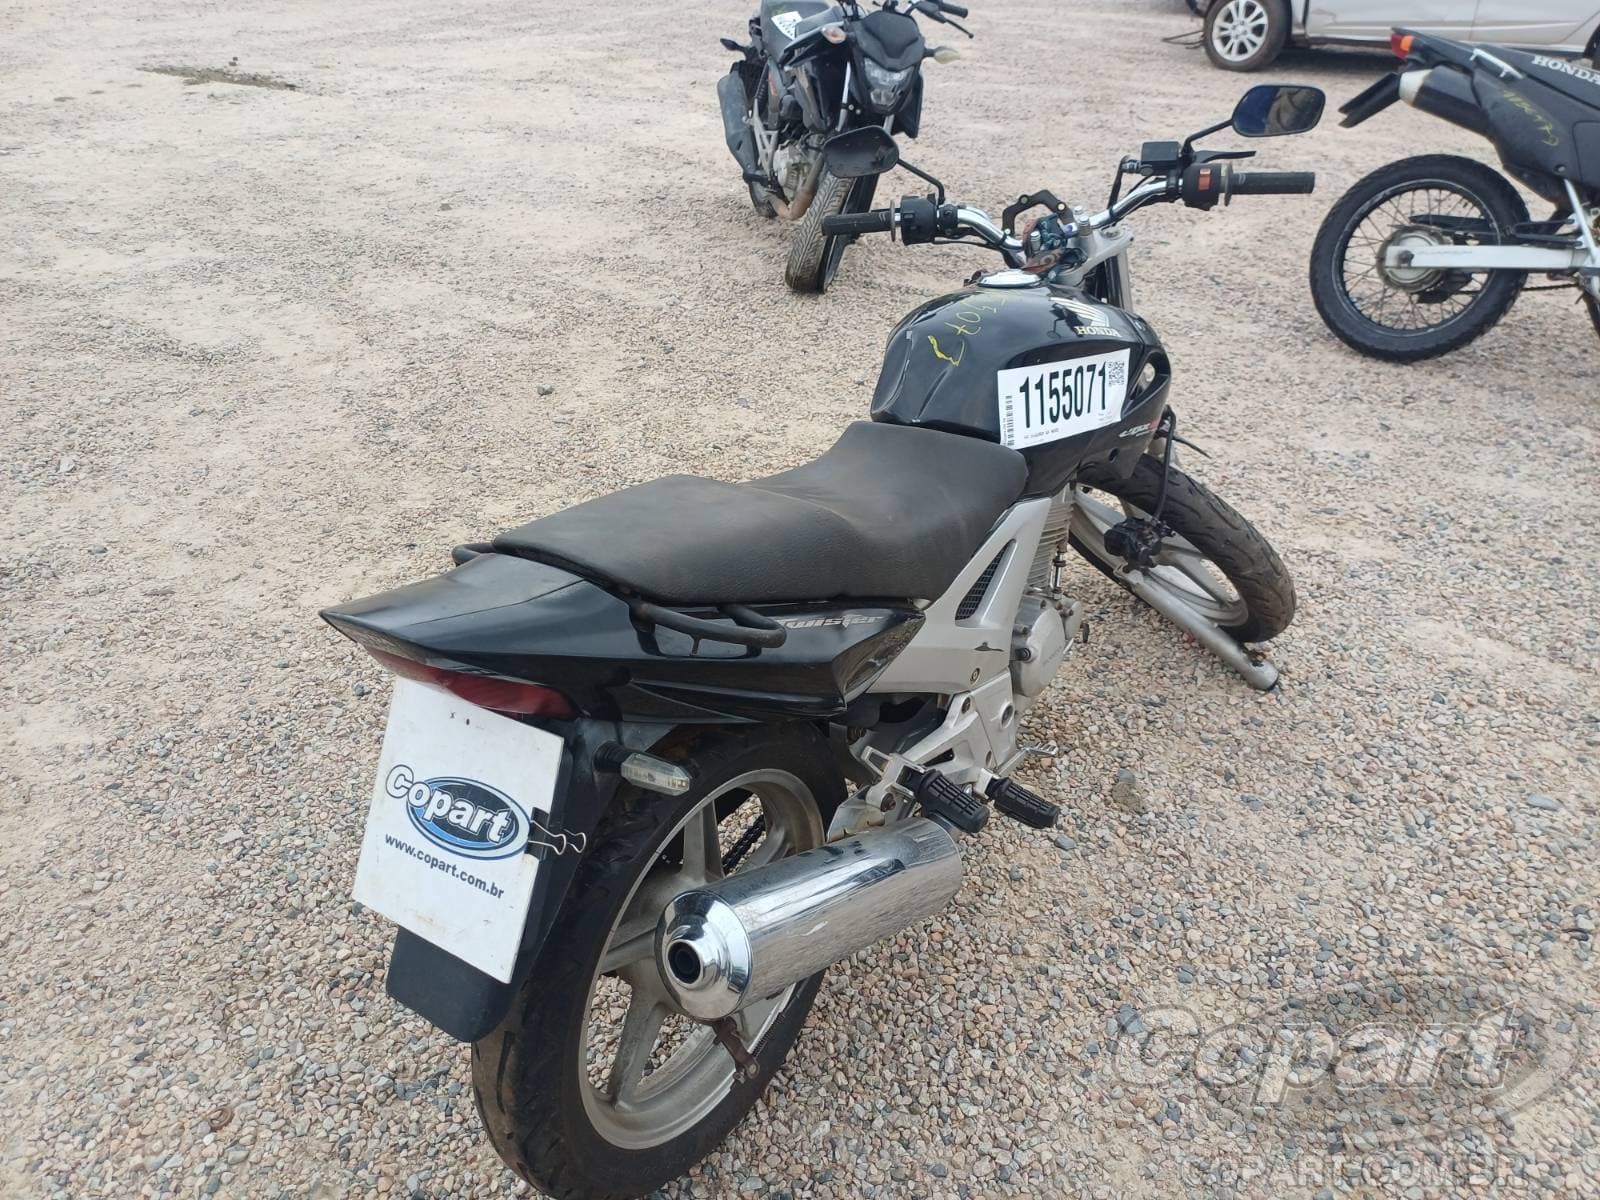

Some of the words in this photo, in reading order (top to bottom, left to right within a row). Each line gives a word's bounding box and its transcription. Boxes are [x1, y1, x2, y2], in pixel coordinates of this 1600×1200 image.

[1531, 54, 1600, 85] HONDA
[1073, 325, 1122, 338] HONDA
[1019, 361, 1106, 428] 1155071
[776, 615, 884, 628] Twister
[385, 764, 514, 844] Copart
[385, 832, 504, 899] www.copart.com.br
